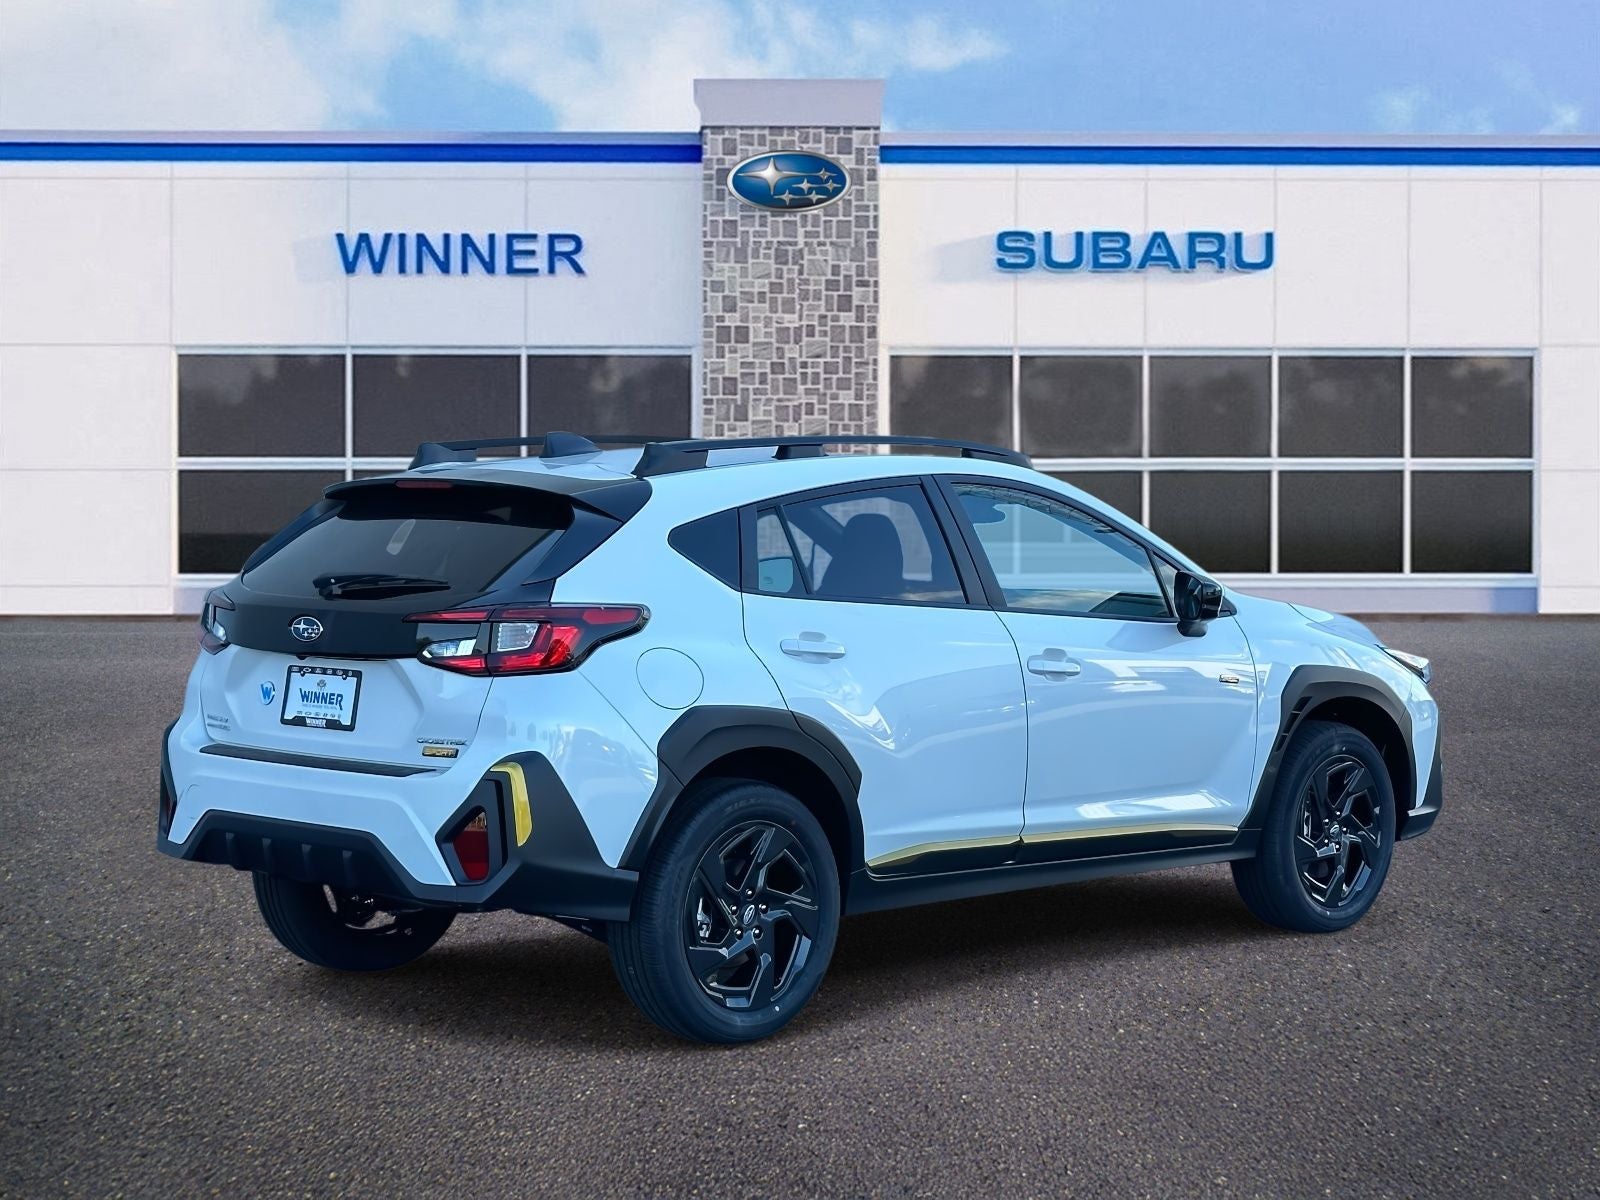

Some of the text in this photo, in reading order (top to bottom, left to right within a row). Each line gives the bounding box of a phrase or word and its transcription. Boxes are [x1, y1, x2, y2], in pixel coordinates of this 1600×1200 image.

[335, 232, 587, 275] WINNER
[995, 230, 1275, 271] SUBARU
[298, 687, 344, 711] WINNER
